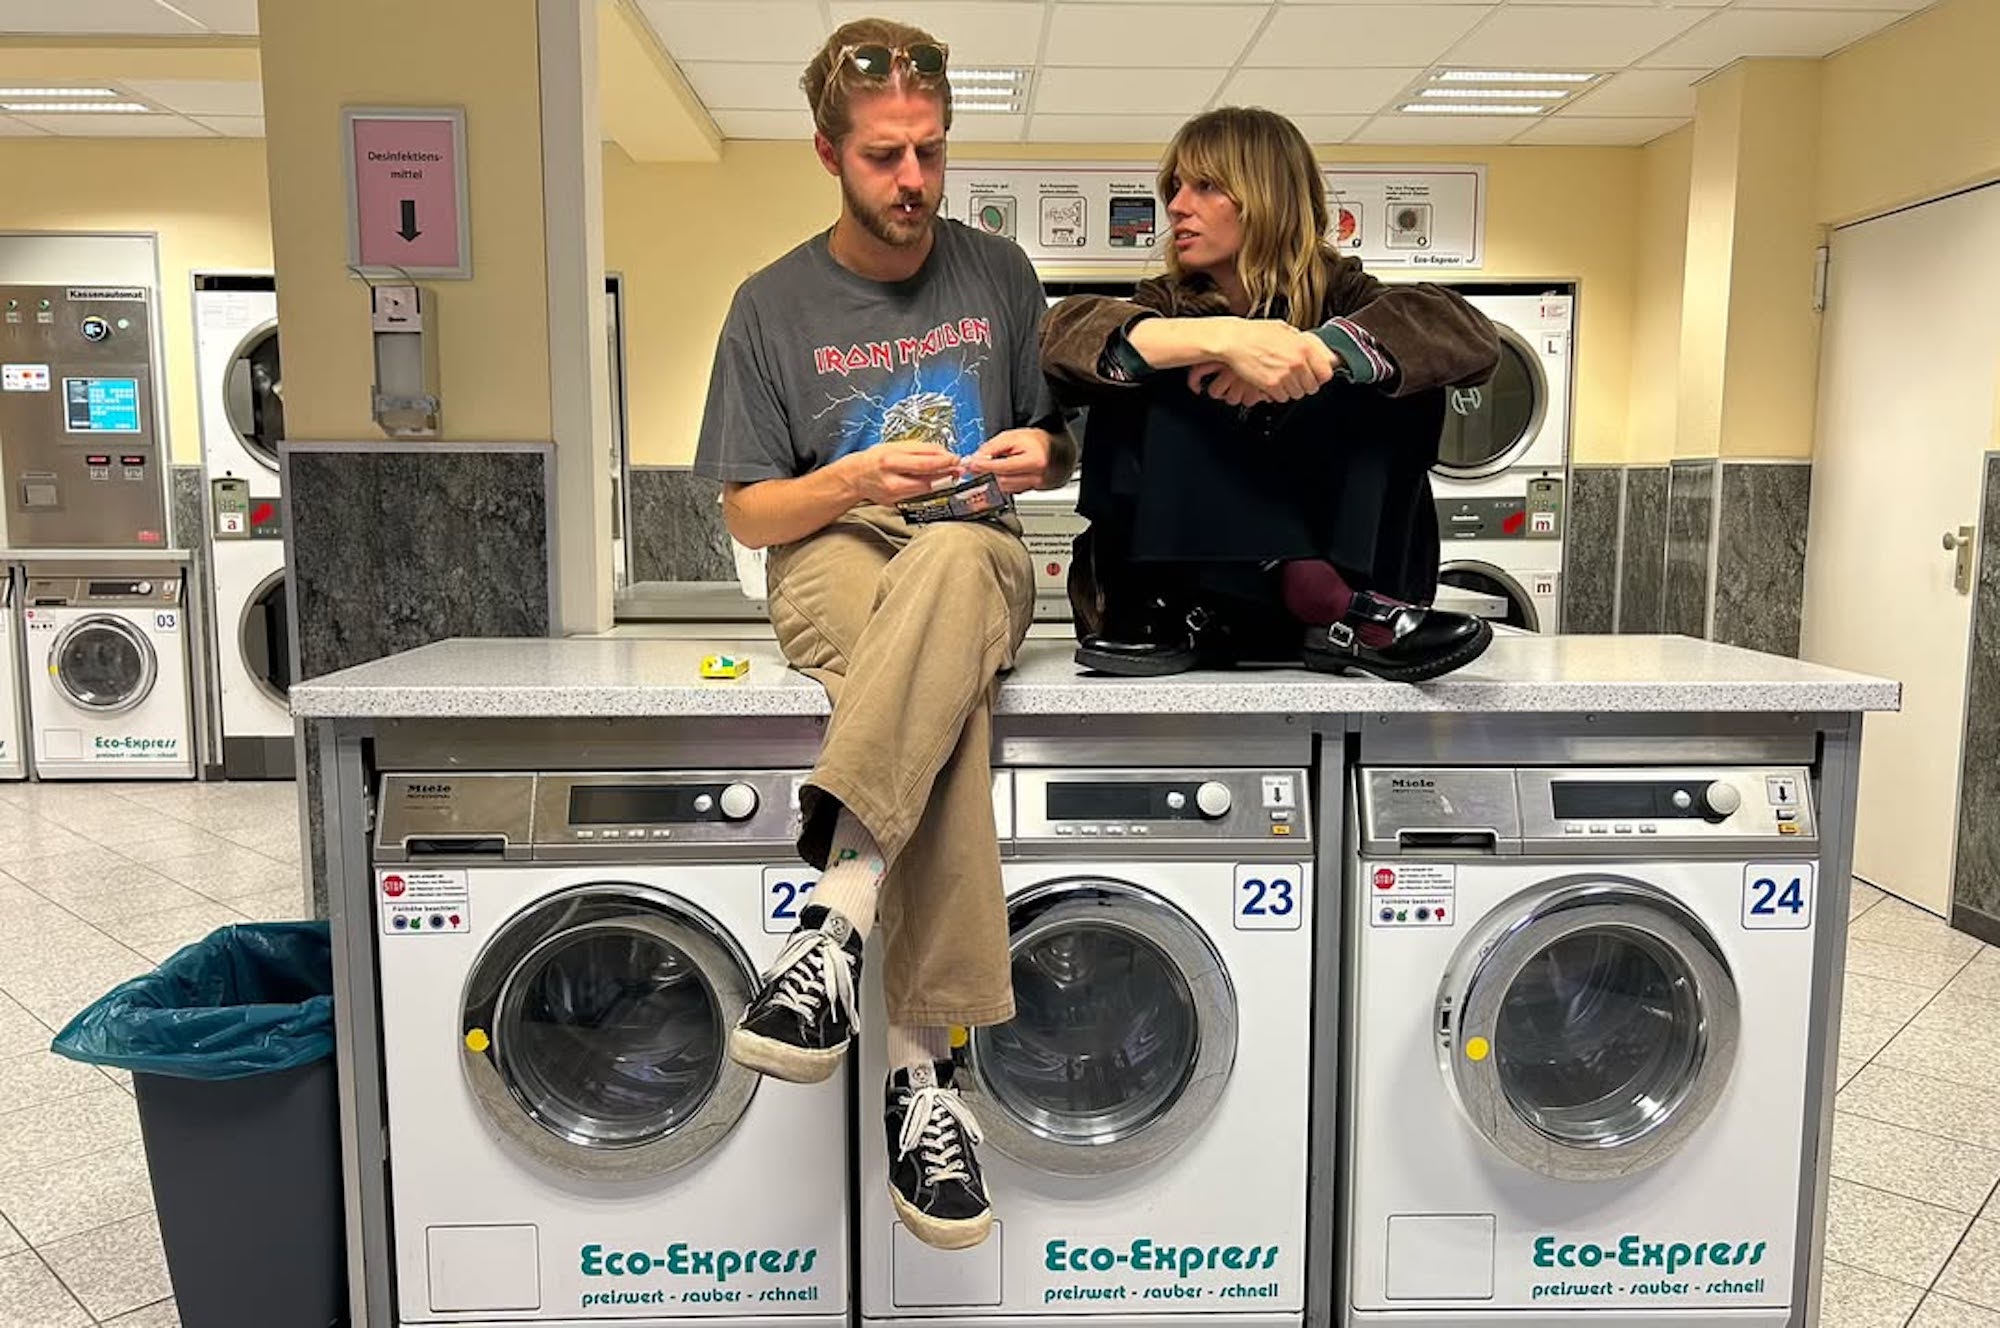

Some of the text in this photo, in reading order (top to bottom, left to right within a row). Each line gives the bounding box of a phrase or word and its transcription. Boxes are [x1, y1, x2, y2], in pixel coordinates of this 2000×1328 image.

[368, 150, 444, 161] Desinfektions-
[391, 168, 423, 179] mittel
[70, 290, 143, 299] Kassenautomat
[814, 317, 992, 377] IRON MAIDEN
[157, 614, 175, 628] 03
[95, 736, 176, 750] Eco-Express
[407, 784, 452, 793] Miele
[1392, 779, 1434, 788] Miele
[1242, 879, 1293, 915] 23
[1750, 878, 1804, 914] 24
[580, 1243, 817, 1282] Eco-Express
[1045, 1239, 1279, 1278] Eco-Express
[1532, 1235, 1766, 1275] Eco-Express
[582, 1290, 664, 1308] preiswert
[680, 1288, 741, 1304] sauber
[759, 1286, 818, 1302] schnell
[1045, 1286, 1126, 1304] preiswert
[1142, 1284, 1202, 1299] sauber
[1219, 1283, 1279, 1298] schnell
[1532, 1282, 1613, 1300] preiswert
[1629, 1278, 1690, 1295] sauber
[1706, 1278, 1765, 1294] schnell
